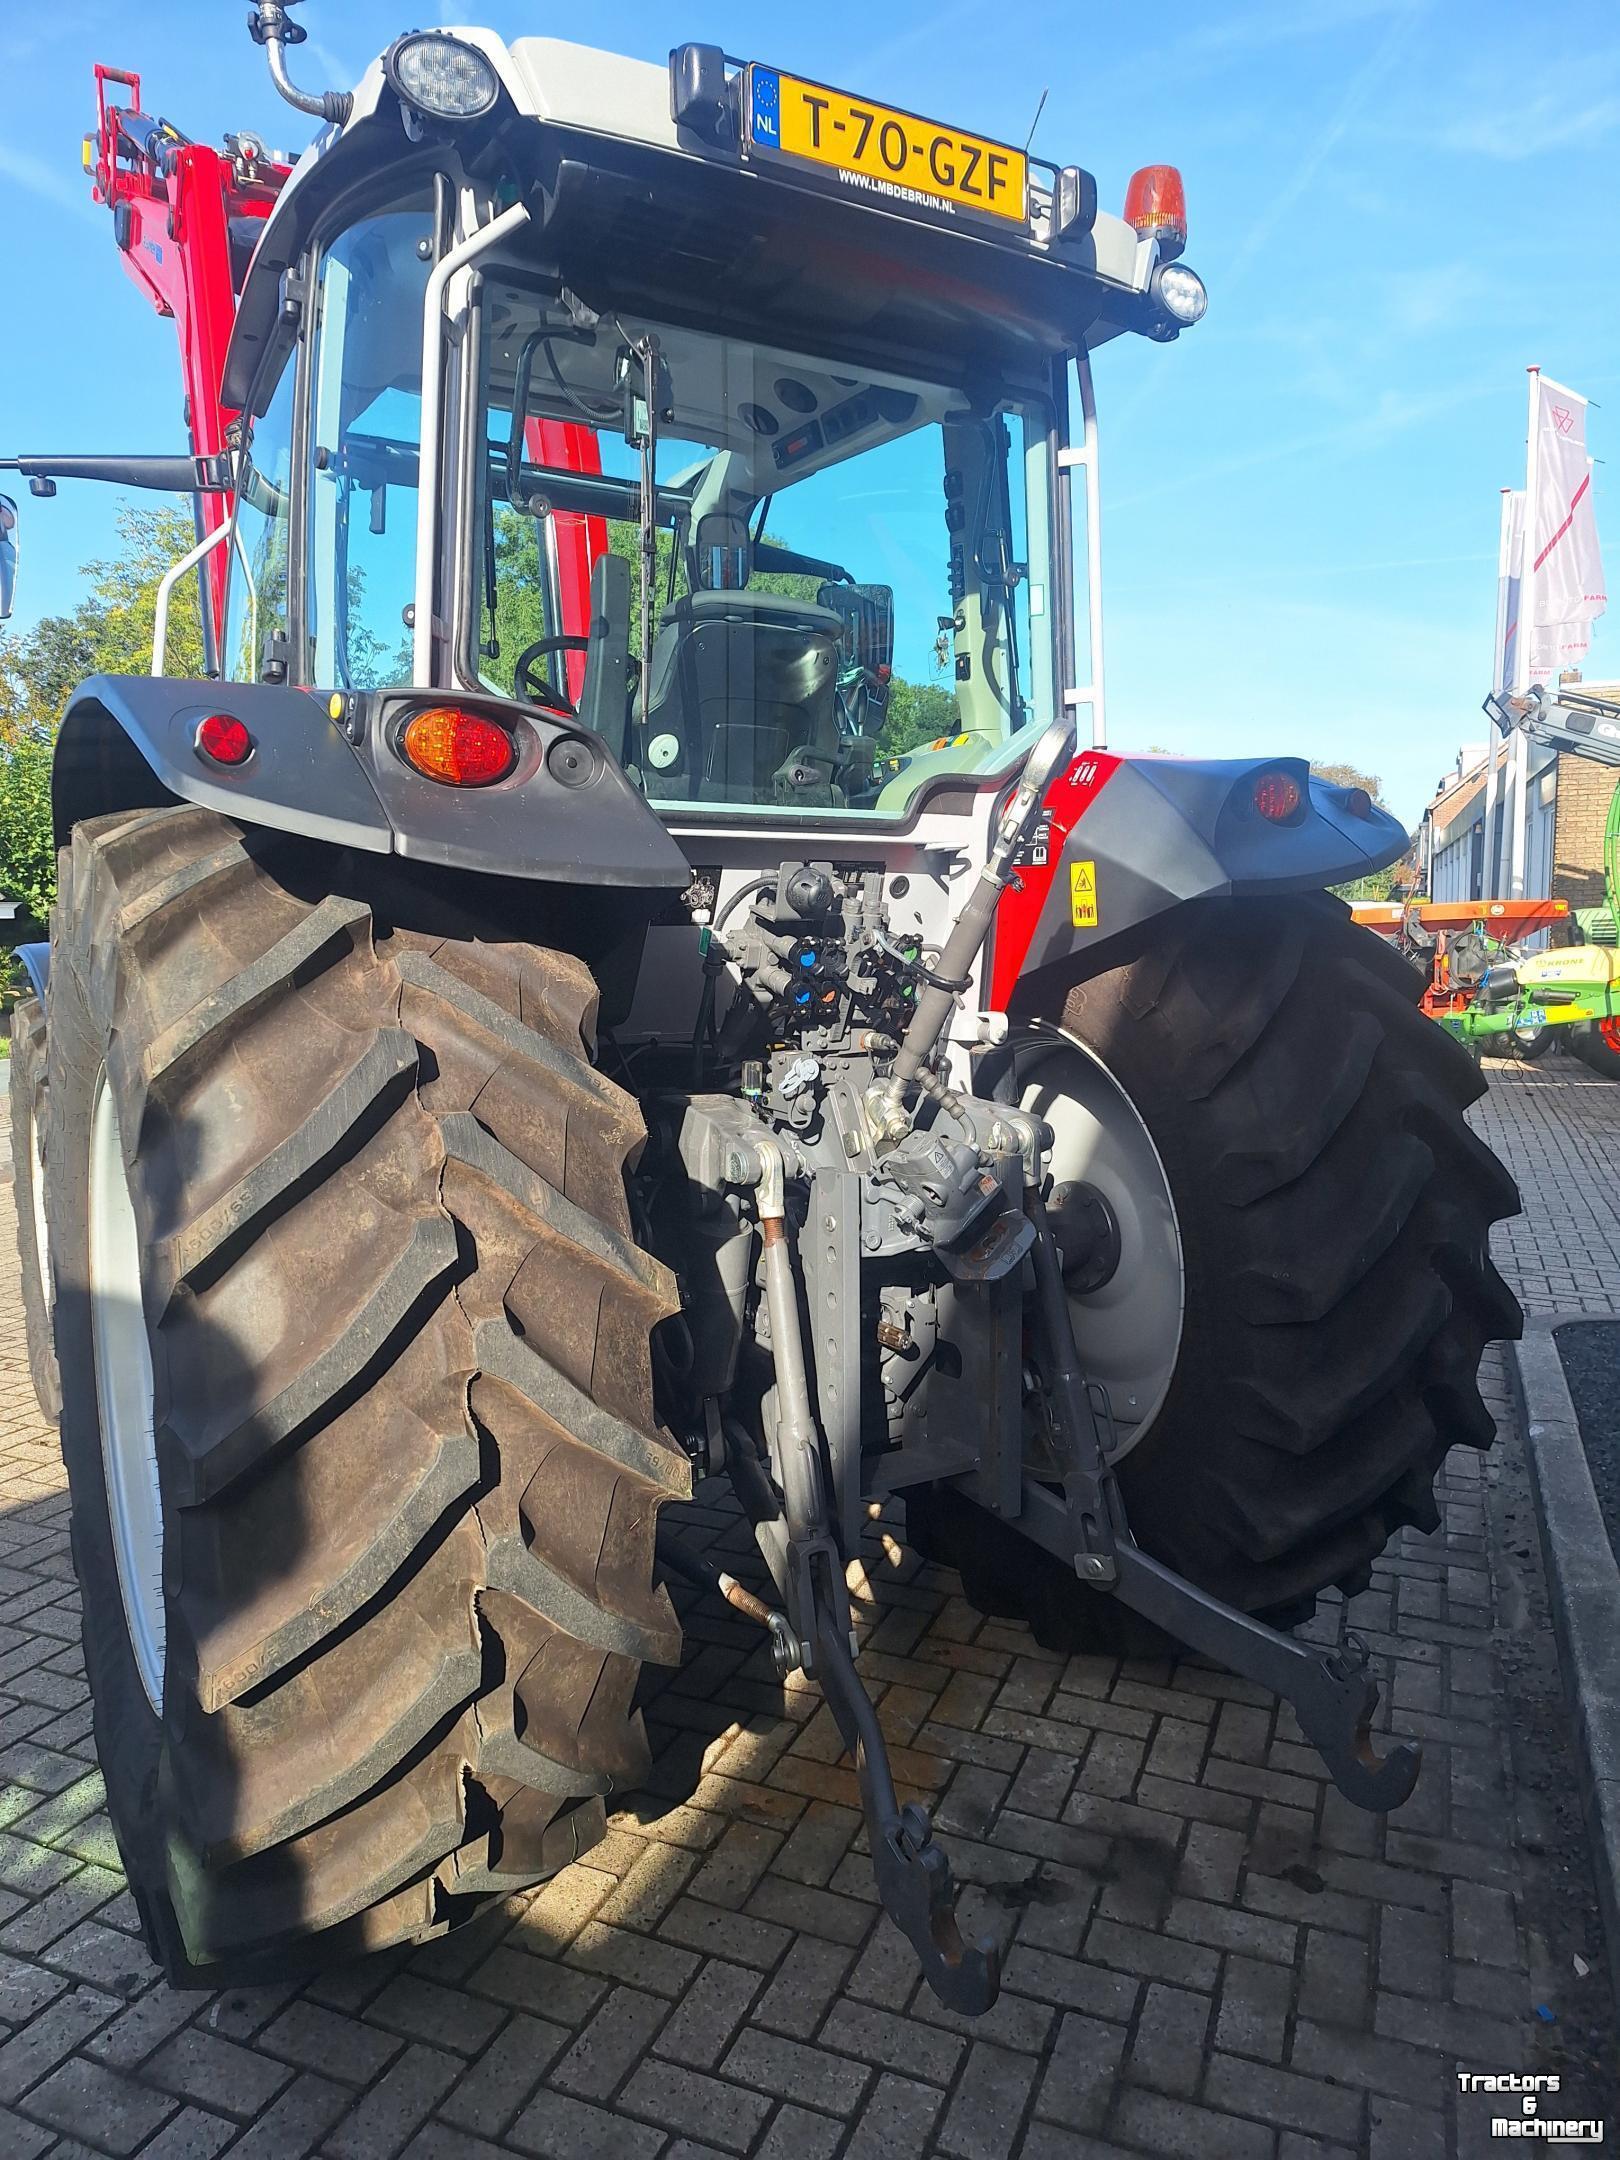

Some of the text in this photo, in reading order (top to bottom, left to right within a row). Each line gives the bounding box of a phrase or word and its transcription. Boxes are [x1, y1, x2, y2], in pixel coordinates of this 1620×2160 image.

[756, 113, 777, 136] NL
[801, 93, 1009, 201] T-70-GZF
[838, 168, 956, 214] WWW.LMBDEBRUIN.NL
[1547, 958, 1585, 967] KRONE
